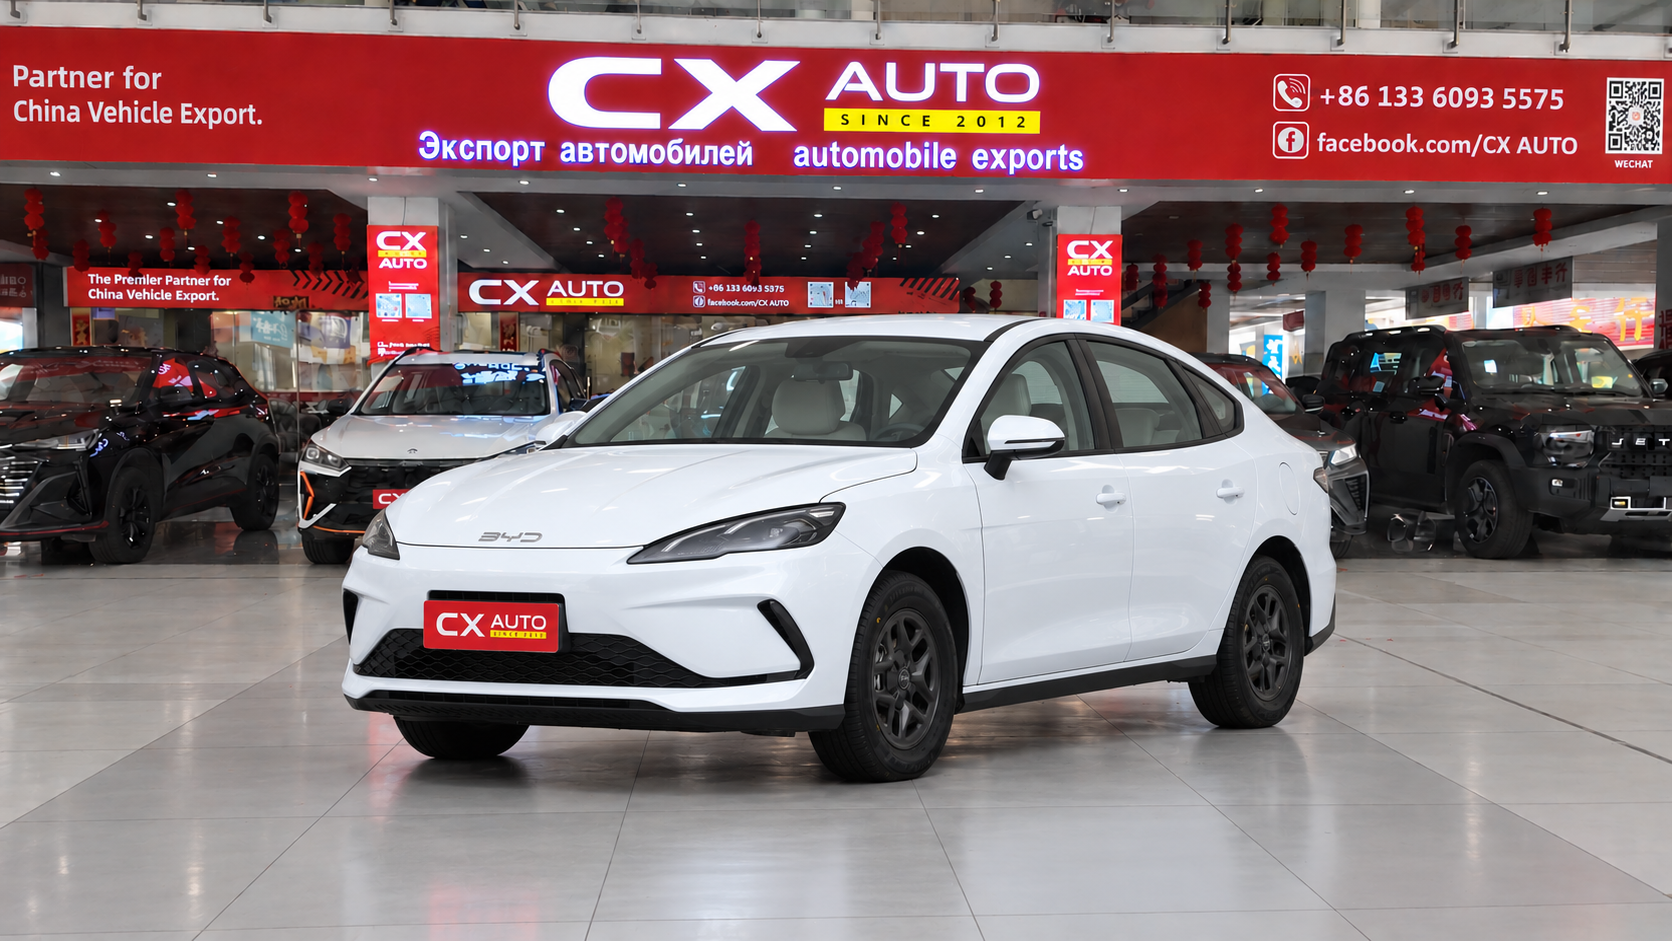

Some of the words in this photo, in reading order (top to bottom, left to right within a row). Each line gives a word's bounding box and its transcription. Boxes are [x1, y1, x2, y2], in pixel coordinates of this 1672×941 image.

[13, 65, 114, 89] Partner
[122, 66, 162, 89] for
[547, 56, 800, 132] CX
[825, 62, 1040, 103] AUTO
[1320, 86, 1369, 107] +86
[1378, 86, 1424, 107] 133
[1433, 87, 1494, 109] 6093
[1503, 88, 1564, 110] 5575
[13, 98, 80, 123] China
[87, 100, 172, 124] Vehicle
[180, 102, 263, 129] Export.
[841, 113, 930, 126] SINCE
[956, 115, 1025, 128] 2012
[418, 131, 545, 168] Экспорт
[559, 140, 753, 166] автомобилей
[1316, 132, 1511, 158] facebook.com/CX
[1517, 136, 1578, 155] AUTO
[794, 144, 957, 170] automobile
[972, 147, 1084, 174] exports
[1614, 159, 1654, 169] WECHAT
[376, 230, 427, 251] CX
[1066, 240, 1114, 259] CX
[378, 258, 428, 269] AUTO
[1067, 265, 1113, 276] AUTO
[87, 273, 111, 284] The
[114, 273, 163, 285] Premier
[166, 275, 211, 287] Partner
[213, 275, 232, 287] for
[726, 284, 740, 292] 133
[87, 288, 123, 300] China
[127, 288, 173, 301] Vehicle
[176, 290, 220, 303] Export.
[468, 279, 540, 306] CX
[546, 280, 624, 298] AUTO
[769, 299, 790, 307] AUTO
[478, 531, 543, 543] BYD
[436, 612, 486, 638] CX
[490, 614, 547, 630] AUTO
